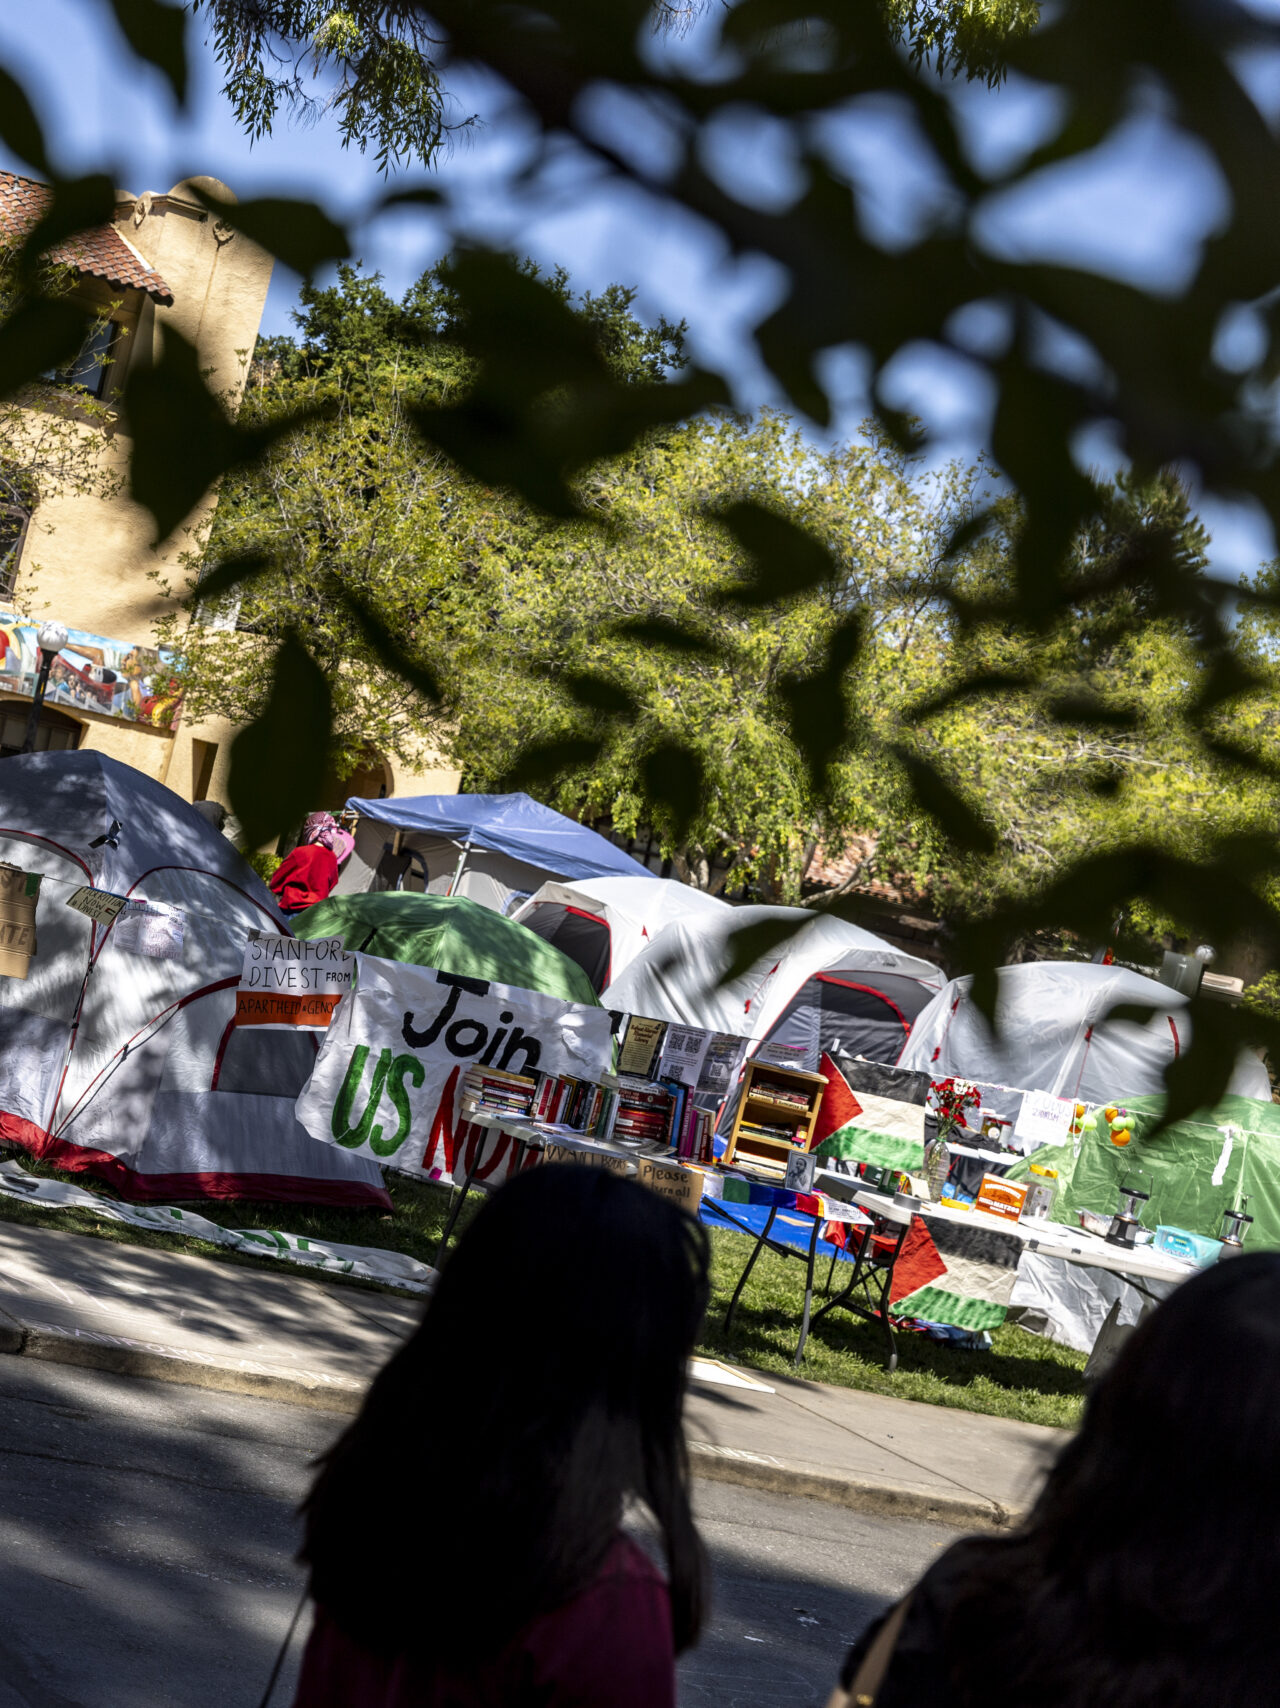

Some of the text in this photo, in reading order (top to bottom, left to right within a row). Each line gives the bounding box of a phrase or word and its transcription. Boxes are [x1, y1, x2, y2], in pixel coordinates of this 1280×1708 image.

[82, 896, 106, 911] NOW
[248, 966, 351, 989] DIVEST FROM
[237, 999, 301, 1016] APARTHEID
[402, 970, 542, 1074] Join
[331, 1045, 426, 1157] US
[643, 1164, 689, 1183] Please
[674, 1184, 690, 1198] all
